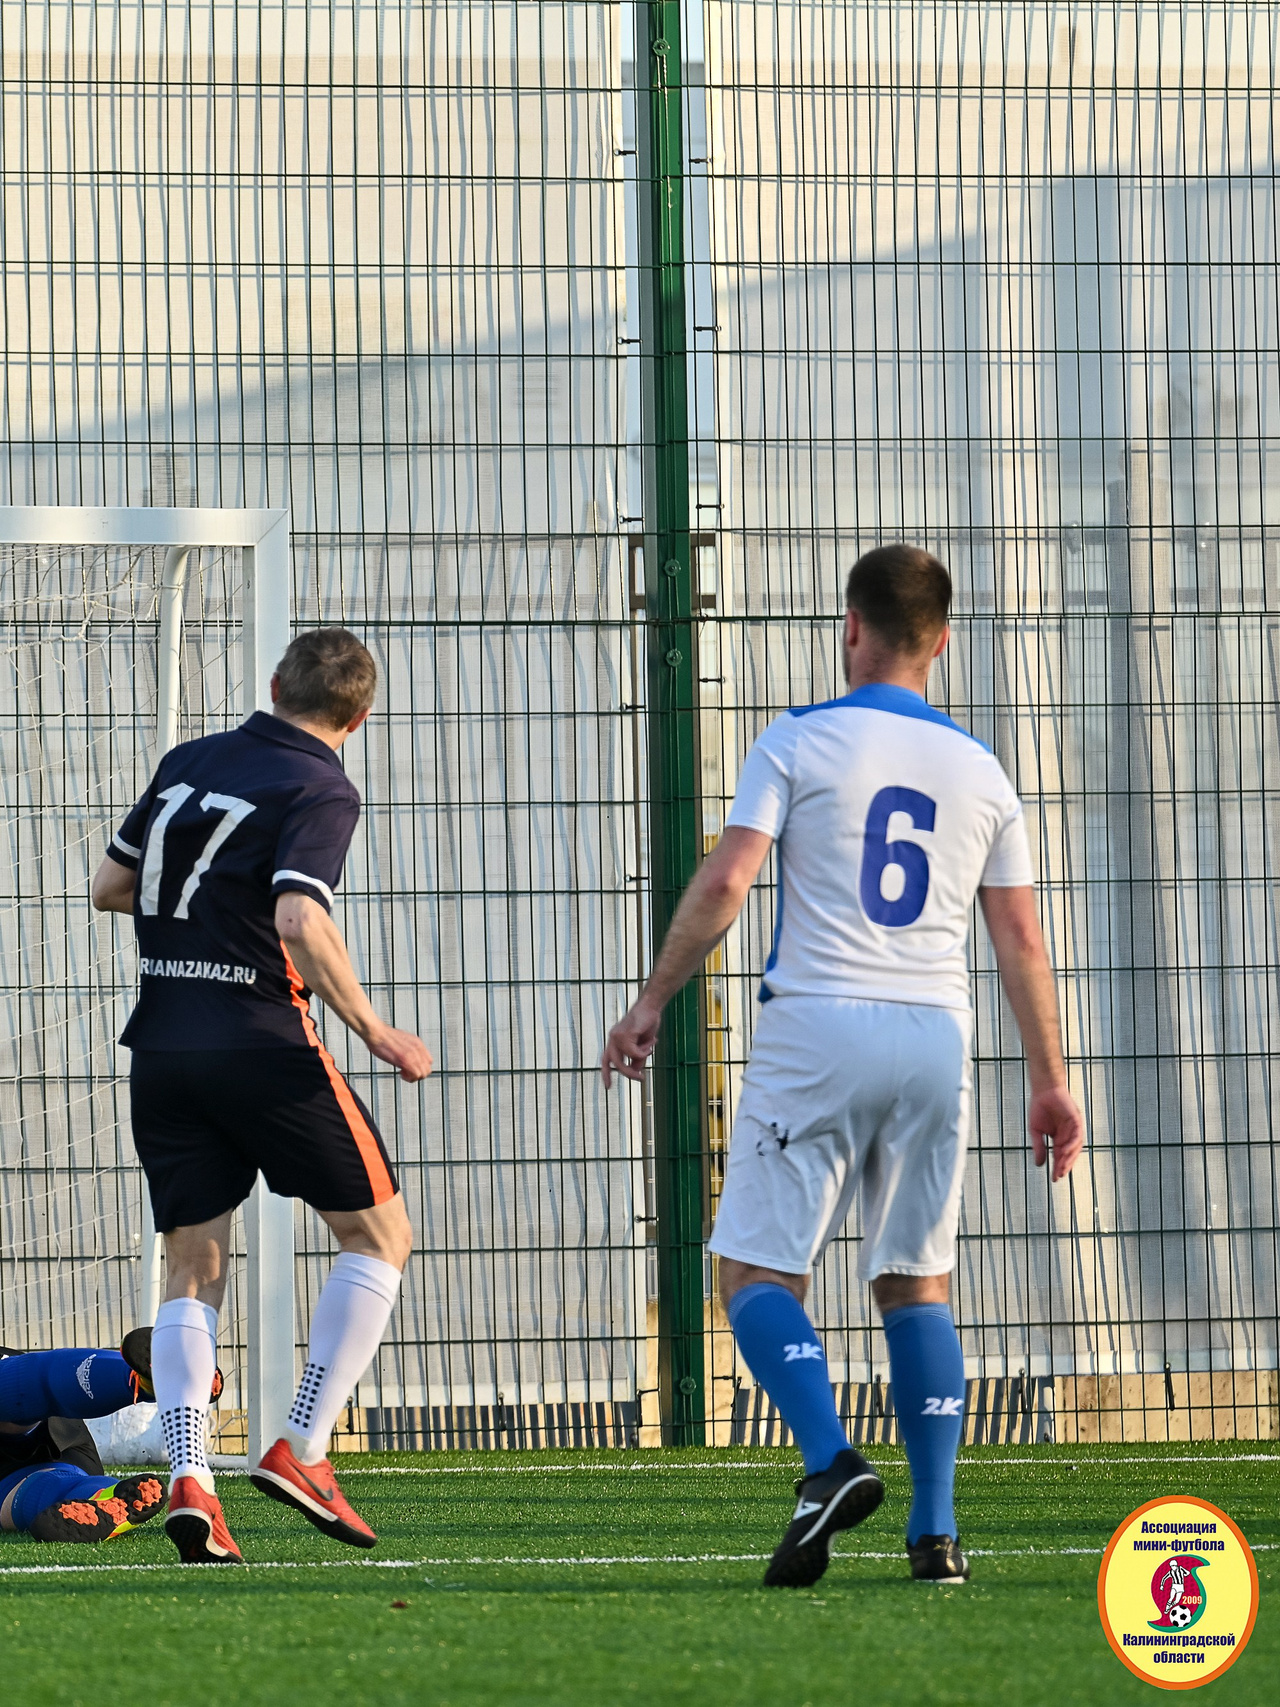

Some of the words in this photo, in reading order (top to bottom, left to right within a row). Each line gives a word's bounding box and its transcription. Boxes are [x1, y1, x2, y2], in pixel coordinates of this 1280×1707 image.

[139, 782, 257, 920] 17
[859, 785, 937, 928] 6
[783, 1342, 824, 1362] 2K
[921, 1397, 965, 1416] 2K
